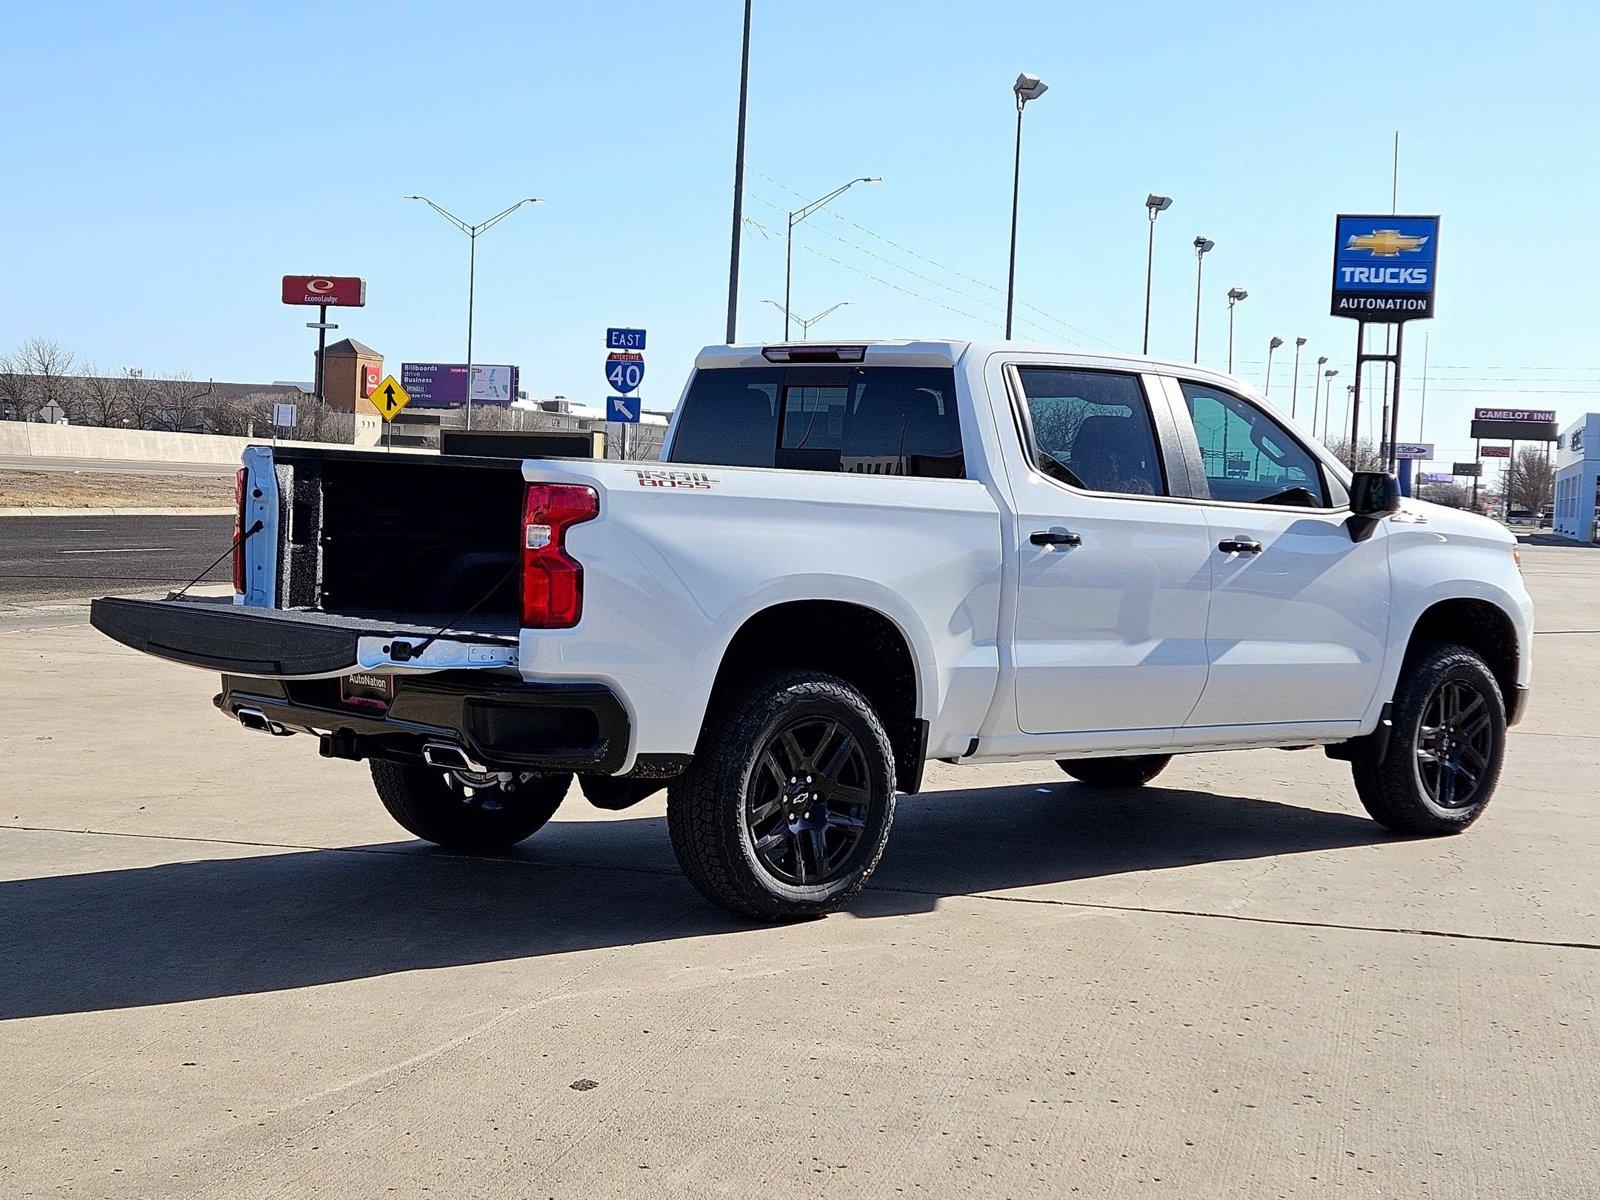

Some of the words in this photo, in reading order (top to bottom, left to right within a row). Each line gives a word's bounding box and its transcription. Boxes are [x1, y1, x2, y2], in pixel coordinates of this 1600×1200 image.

[1341, 267, 1427, 284] TRUCKS
[1339, 298, 1427, 310] AUTONATION
[611, 332, 641, 346] EAST
[404, 364, 438, 372] Billboards
[609, 365, 640, 387] 40
[1479, 410, 1530, 420] CAMELOT
[1533, 412, 1553, 421] INN
[623, 469, 721, 483] TRAIL
[638, 479, 711, 489] BOSS
[349, 674, 387, 689] AutoNation
